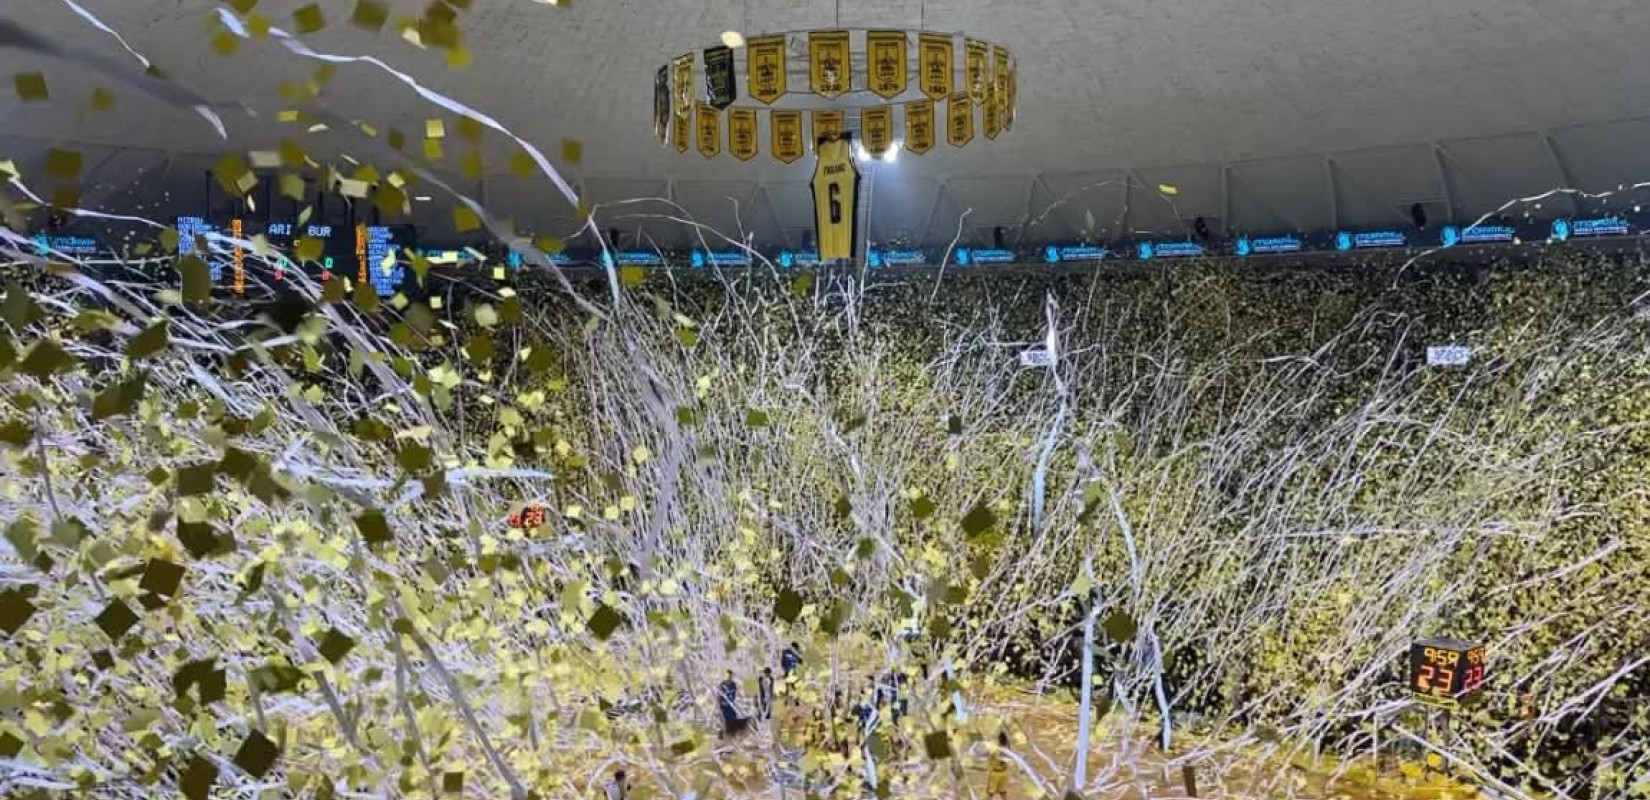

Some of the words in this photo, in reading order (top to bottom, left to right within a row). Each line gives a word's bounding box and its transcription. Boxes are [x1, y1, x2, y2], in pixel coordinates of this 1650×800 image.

[828, 183, 841, 224] 6
[268, 223, 292, 235] ARI
[307, 225, 332, 237] BUR
[324, 257, 333, 268] 0
[1424, 647, 1460, 667] 9:59
[1417, 665, 1453, 693] 23
